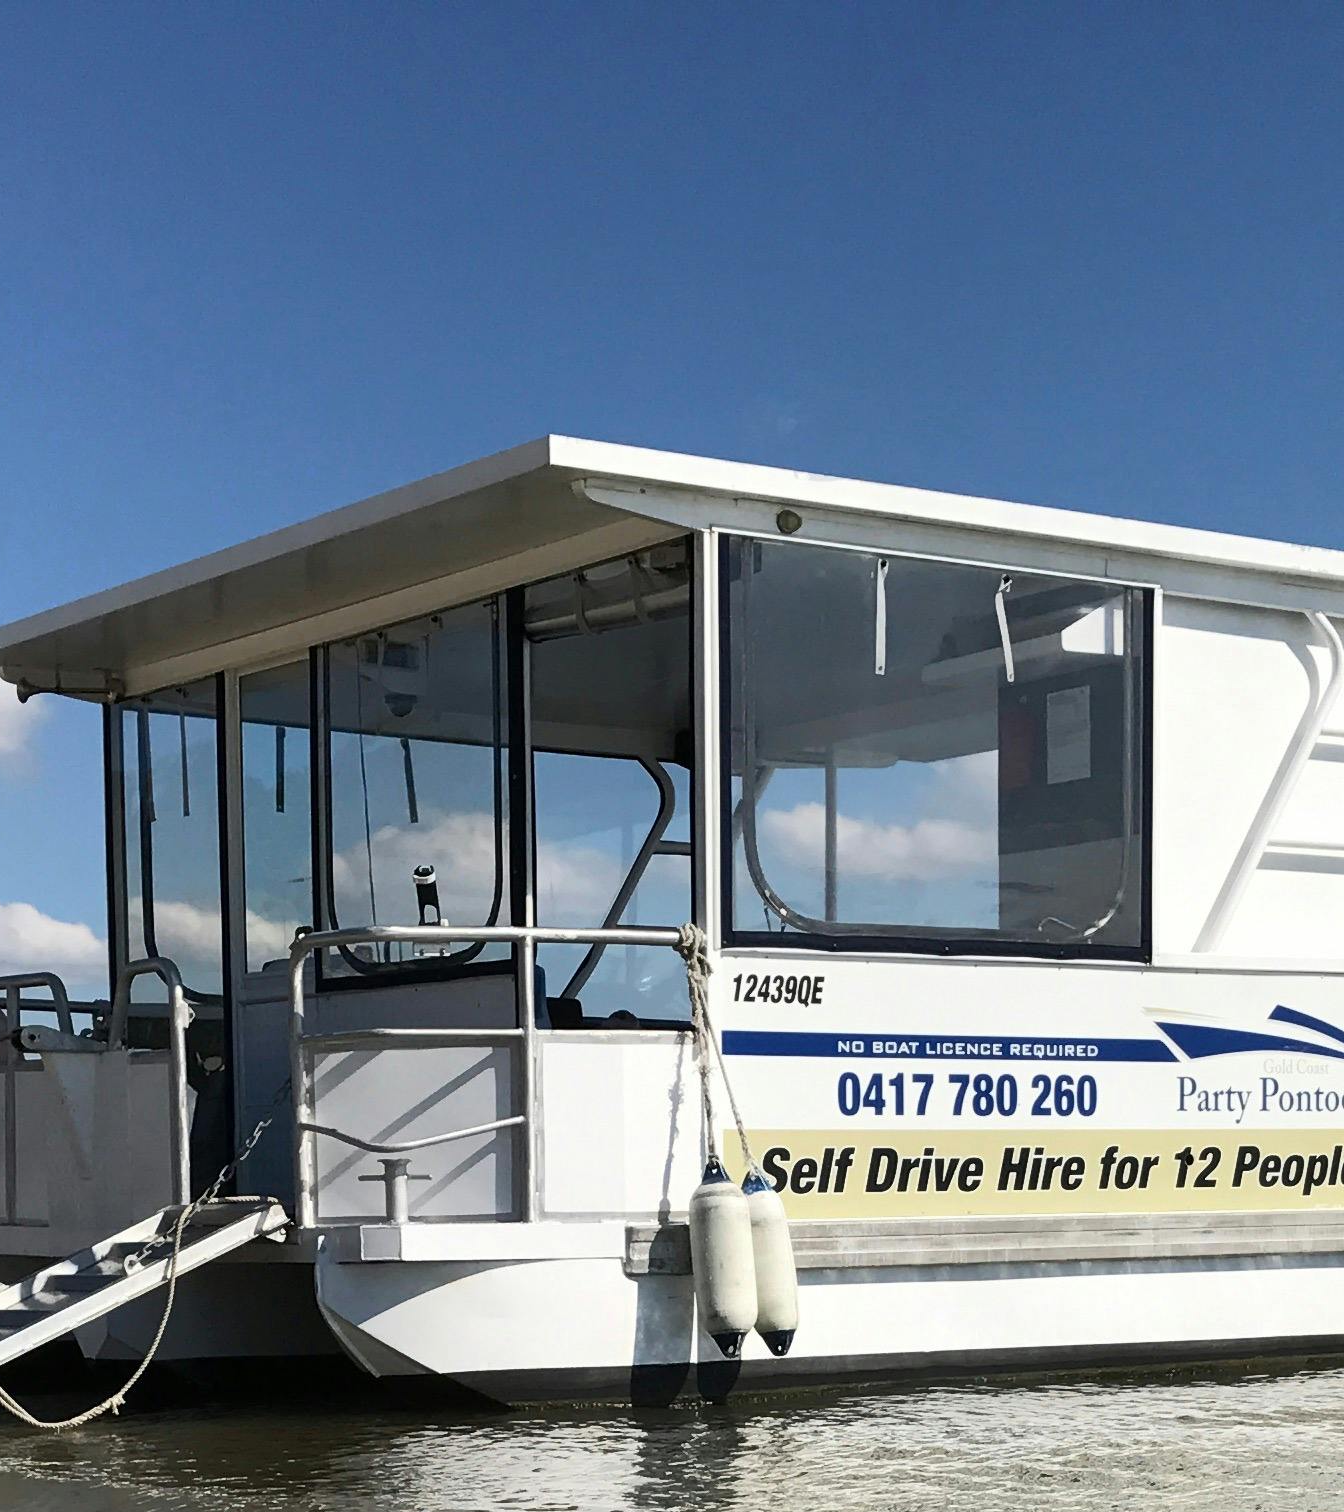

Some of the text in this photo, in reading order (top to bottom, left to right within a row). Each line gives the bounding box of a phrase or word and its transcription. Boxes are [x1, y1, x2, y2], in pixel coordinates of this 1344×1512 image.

[733, 973, 825, 1008] 12439QE
[837, 1040, 1099, 1059] NO BOAT LICENCE REQUIRED
[1263, 1058, 1294, 1075] Gold
[837, 1071, 1098, 1118] 0417 780 260
[1176, 1076, 1252, 1124] Party
[762, 1147, 856, 1195] Self
[865, 1147, 984, 1193] Drive
[996, 1147, 1086, 1191] Hire
[1098, 1146, 1160, 1190] for
[1174, 1146, 1222, 1188] 12
